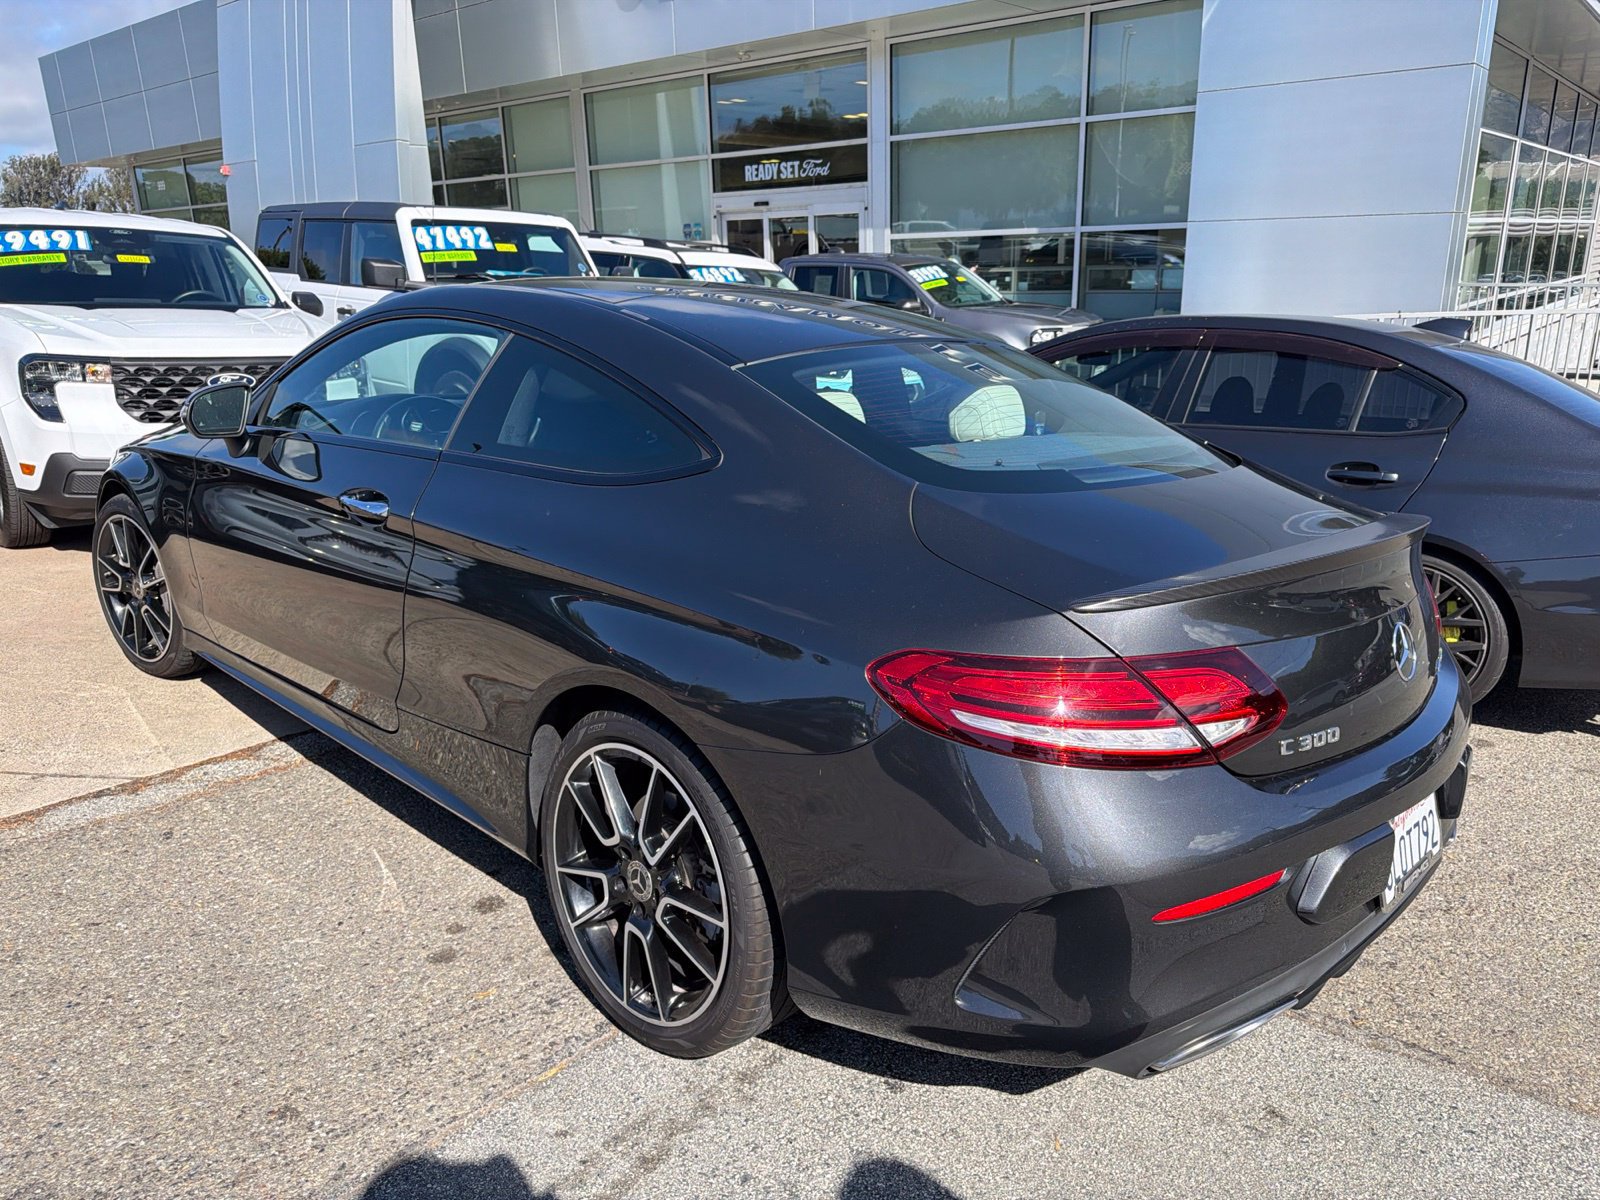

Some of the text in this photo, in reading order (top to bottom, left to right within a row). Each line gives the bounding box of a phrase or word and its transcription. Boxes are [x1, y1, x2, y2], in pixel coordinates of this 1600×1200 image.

[745, 159, 831, 182] READY SET Ford
[0, 229, 91, 251] 9491
[415, 226, 495, 250] 47492
[21, 254, 61, 263] WARRANTY
[1279, 726, 1341, 756] C 300
[1386, 809, 1438, 892] LOT792
